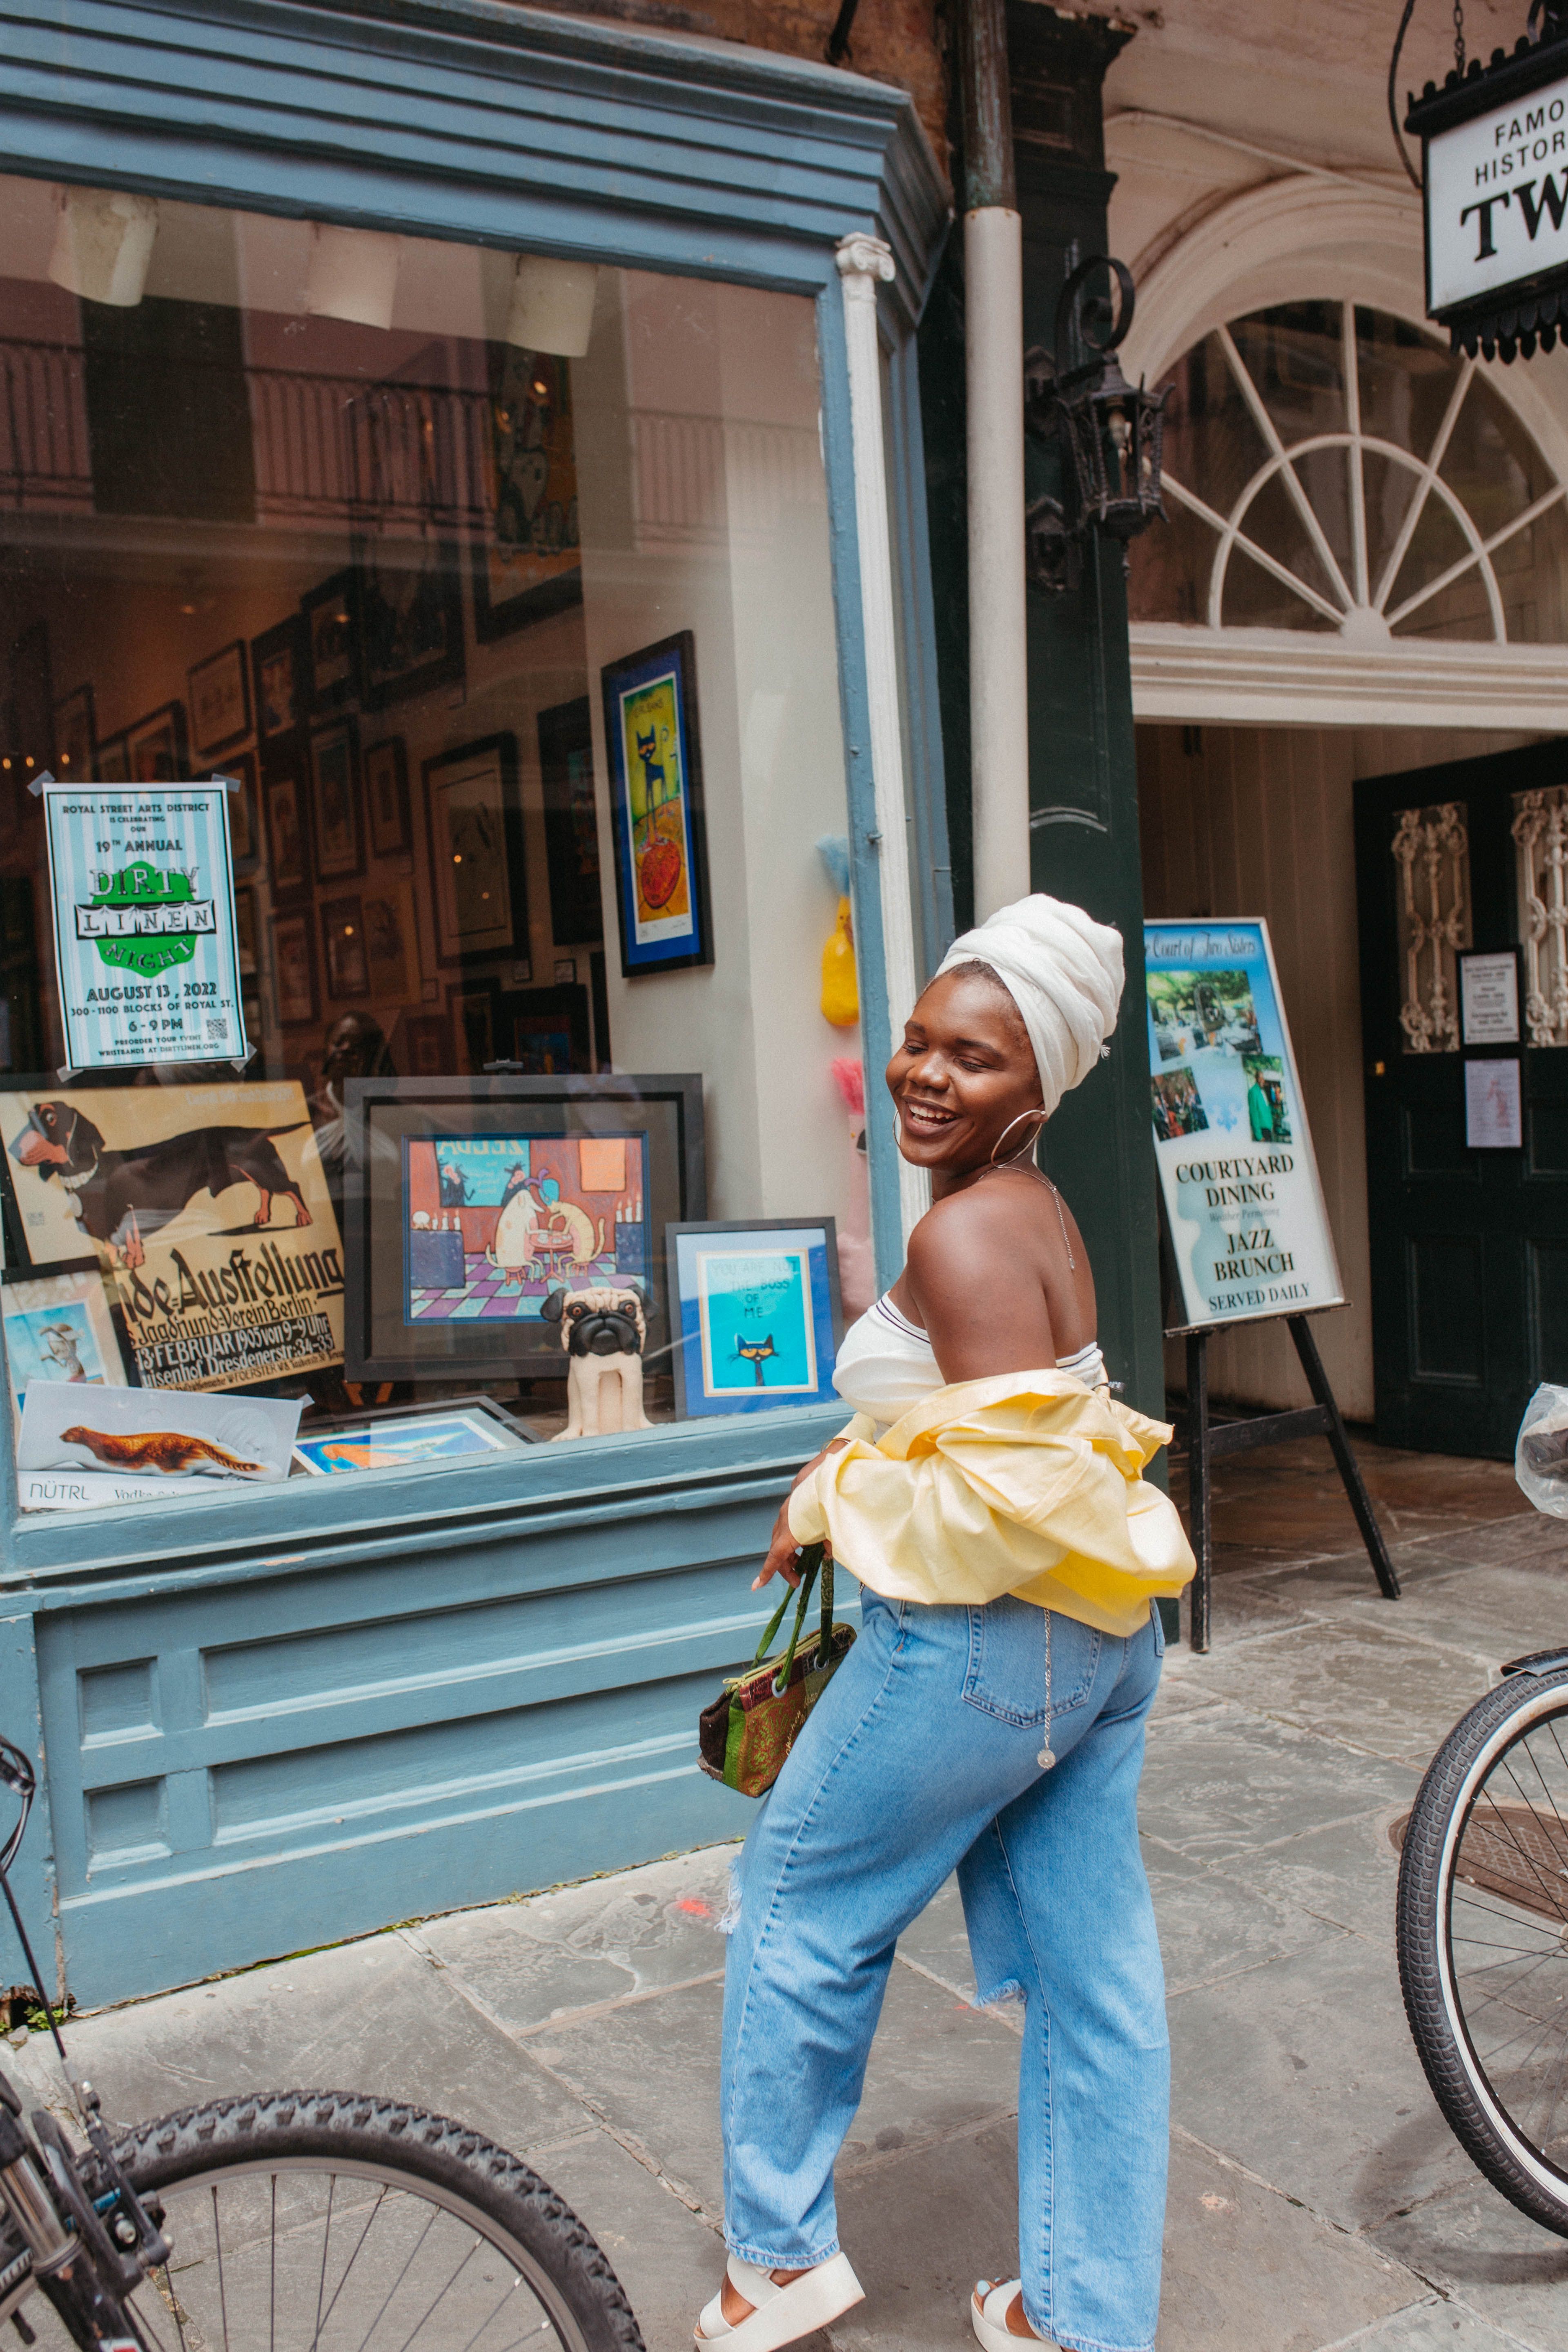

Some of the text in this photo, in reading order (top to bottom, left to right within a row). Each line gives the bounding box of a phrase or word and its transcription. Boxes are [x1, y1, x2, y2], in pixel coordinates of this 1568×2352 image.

[1495, 100, 1564, 147] FAMO
[1475, 130, 1566, 186] HISTOR
[1460, 167, 1568, 262] TW
[62, 803, 209, 814] ROYAL STREET ARTS DISTRICT
[125, 840, 183, 852] ANNUAL
[89, 866, 200, 896] DIRTY
[84, 909, 208, 931] LINEN
[105, 938, 194, 969] NIGHT
[87, 985, 151, 1002] AUGUST
[184, 982, 217, 997] 2022
[124, 1003, 162, 1013] BLOCKS
[167, 1002, 180, 1011] OF
[185, 1000, 217, 1009] ROYAL
[220, 1000, 234, 1008] ST.
[162, 1018, 183, 1030] PM
[98, 1049, 145, 1057] WRISTBANDS
[1176, 1154, 1294, 1184] COURTYARD
[1205, 1181, 1275, 1207] DINING
[1209, 1212, 1239, 1222] Weather
[1227, 1228, 1274, 1256] JAZZ
[1214, 1252, 1295, 1282] BRUNCH
[744, 1293, 759, 1303] OF
[1208, 1282, 1310, 1312] SERVED DAILY
[744, 1307, 763, 1319] ME
